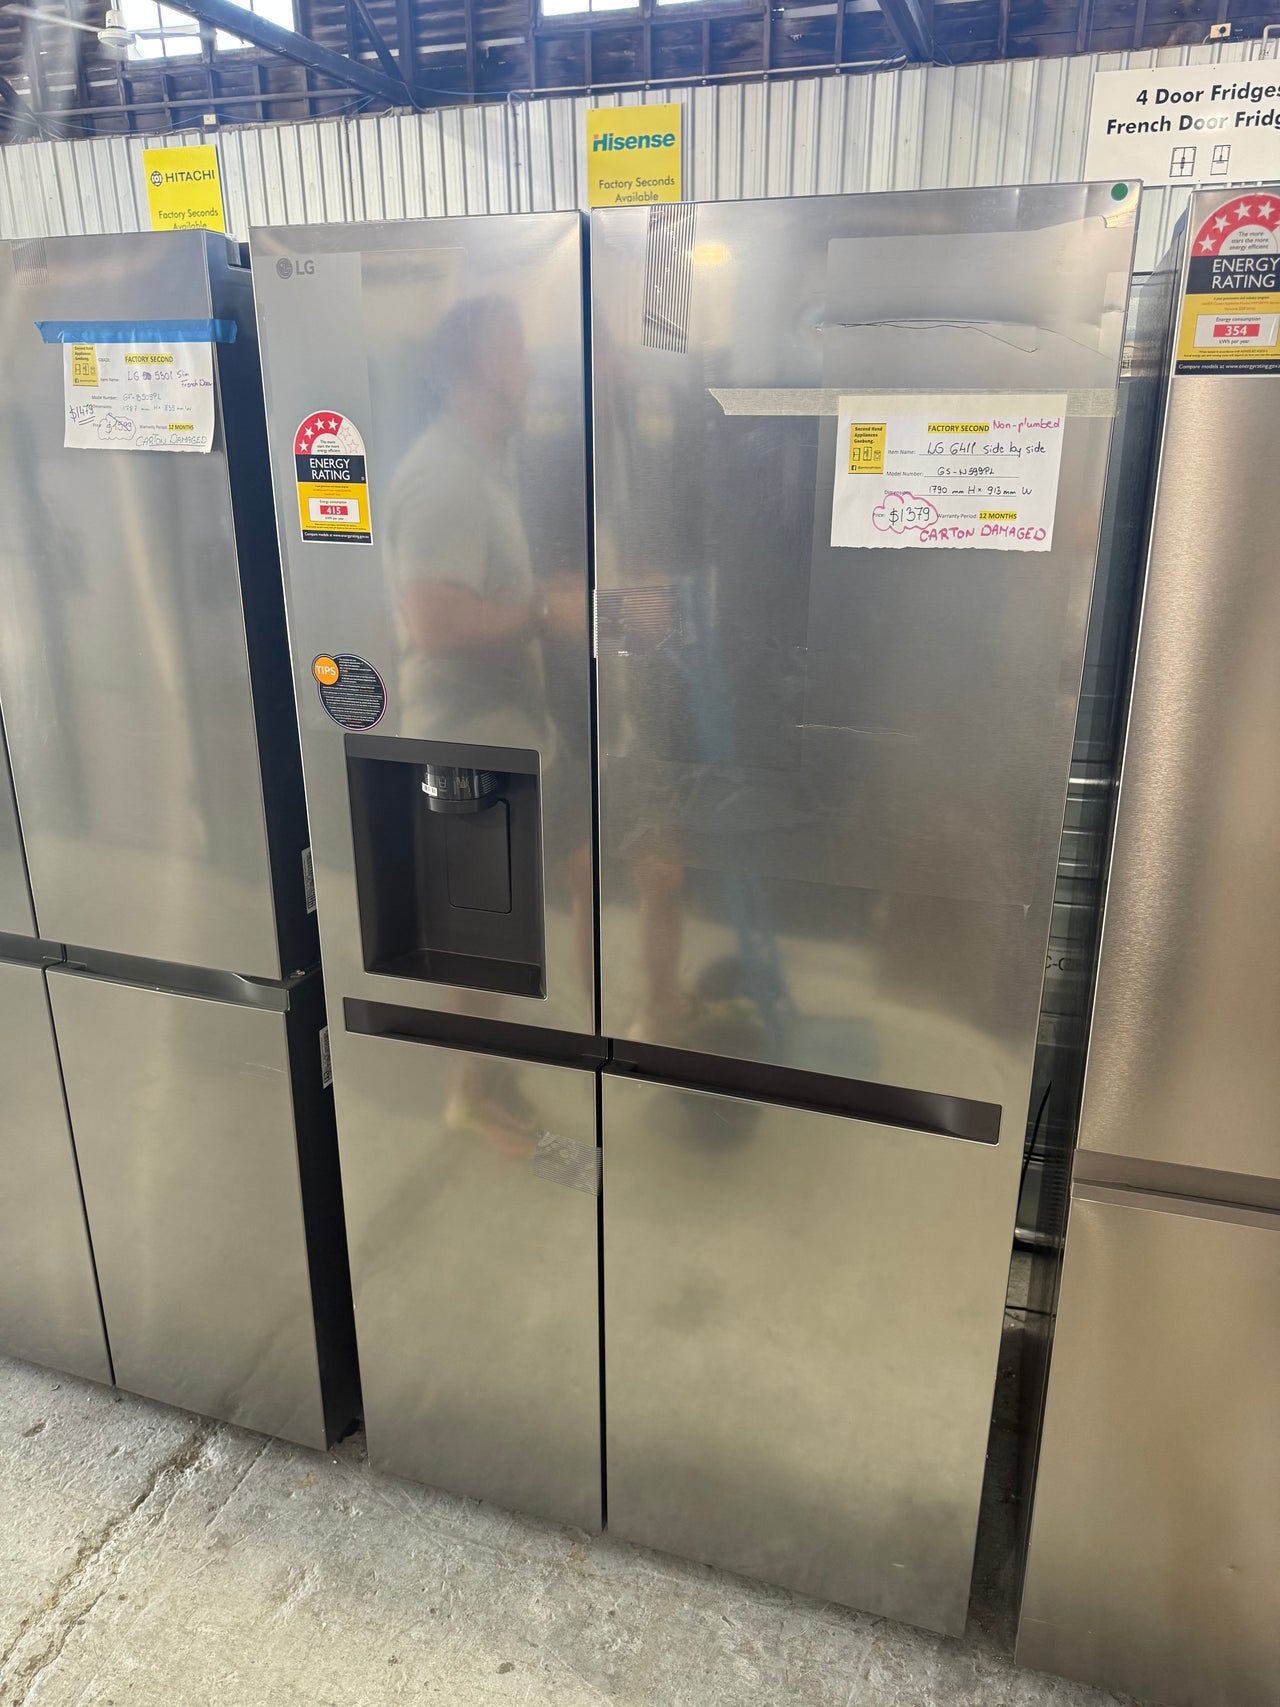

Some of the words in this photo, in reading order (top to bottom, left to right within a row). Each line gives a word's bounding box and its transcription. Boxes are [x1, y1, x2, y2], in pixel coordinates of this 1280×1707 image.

[1136, 90, 1148, 105] 4
[1155, 88, 1204, 104] Door
[1107, 115, 1171, 135] French
[1178, 114, 1229, 131] Door
[592, 132, 676, 152] Hisense
[165, 170, 215, 182] HITACHI
[599, 180, 633, 190] Factory
[635, 176, 675, 187] Seconds
[615, 191, 659, 202] Available
[158, 211, 185, 220] Factory
[187, 207, 219, 218] Seconds
[295, 259, 315, 275] LG
[1212, 257, 1280, 273] ENERGY
[1211, 273, 1276, 289] RATING
[1224, 325, 1247, 336] 354
[127, 370, 139, 381] LG
[993, 417, 1060, 433] Non-plumbed
[927, 442, 944, 455] LG
[983, 442, 1004, 454] side
[1009, 441, 1021, 458] by
[1025, 441, 1046, 454] side
[309, 457, 350, 469] ENERGY
[311, 469, 351, 481] RATING
[929, 485, 947, 495] 1790
[967, 485, 976, 494] H
[987, 486, 1001, 495] 913
[1021, 487, 1033, 495] W
[326, 506, 341, 515] 415
[888, 506, 930, 525] $1379
[919, 527, 975, 543] CARTON
[980, 524, 1046, 541] DAMAGED
[315, 665, 336, 676] TIPS
